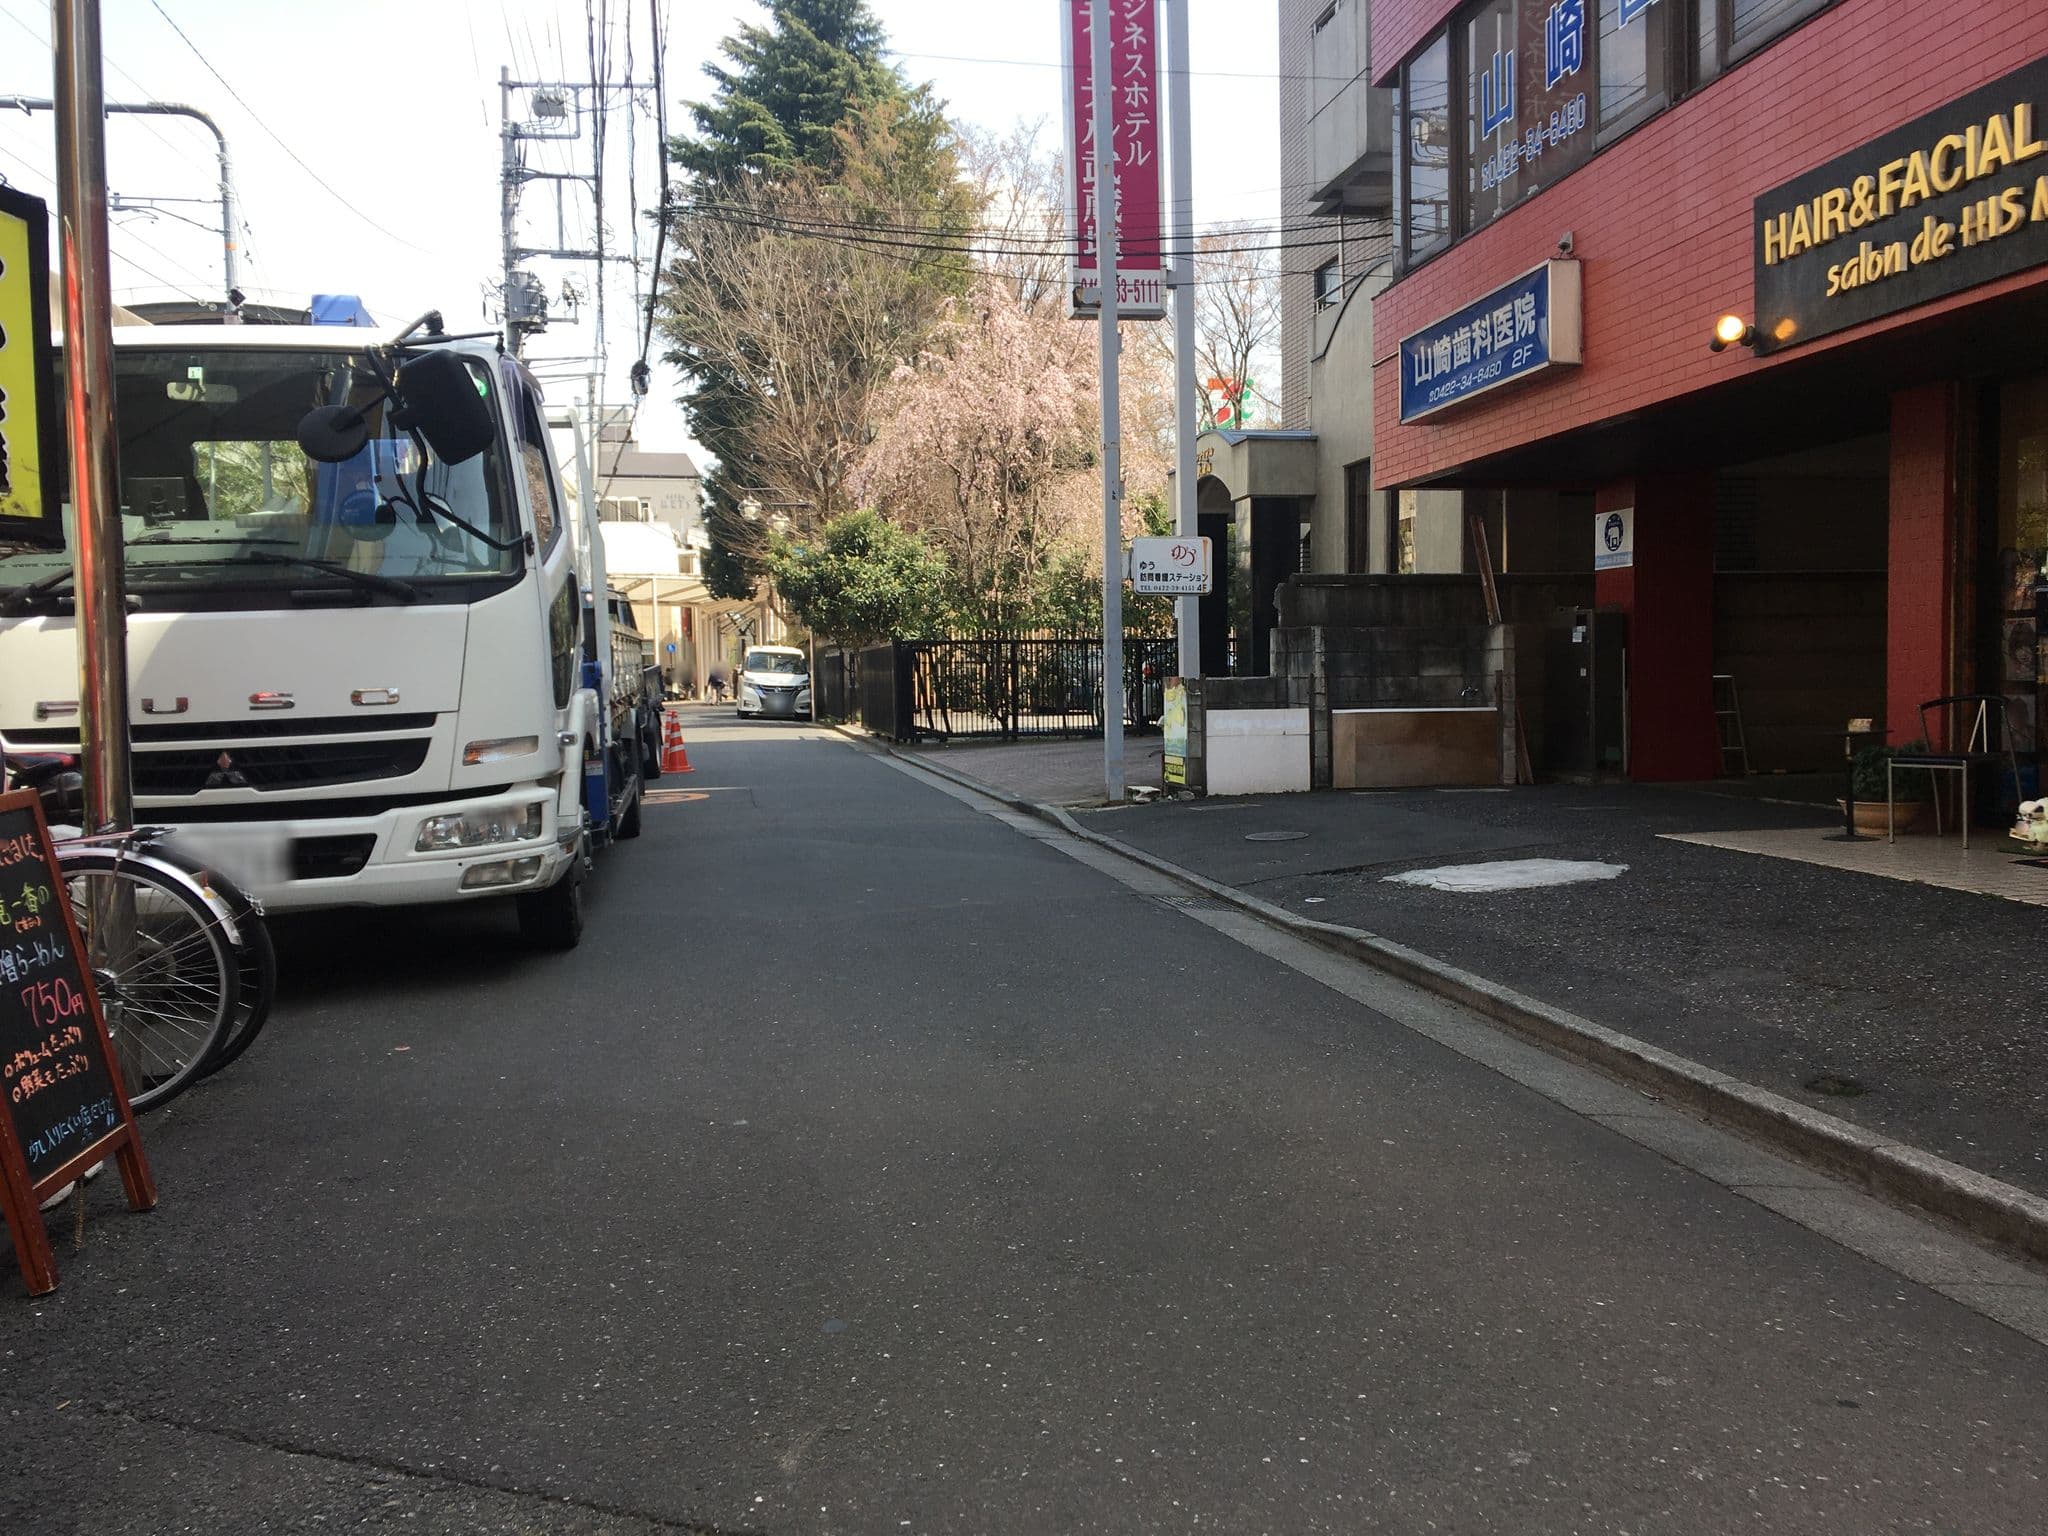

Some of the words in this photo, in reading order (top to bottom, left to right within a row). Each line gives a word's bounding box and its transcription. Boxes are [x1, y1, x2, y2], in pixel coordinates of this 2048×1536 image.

[1764, 103, 2048, 266] HAIR&FACIAL
[1826, 241, 1907, 297] salon
[1910, 215, 1955, 265] de
[1960, 187, 2026, 247] HIS
[1414, 292, 1536, 387] 山崎歯科医院
[1511, 344, 1533, 369] 2F
[34, 687, 400, 721] FUSO
[21, 978, 85, 1028] 750円
